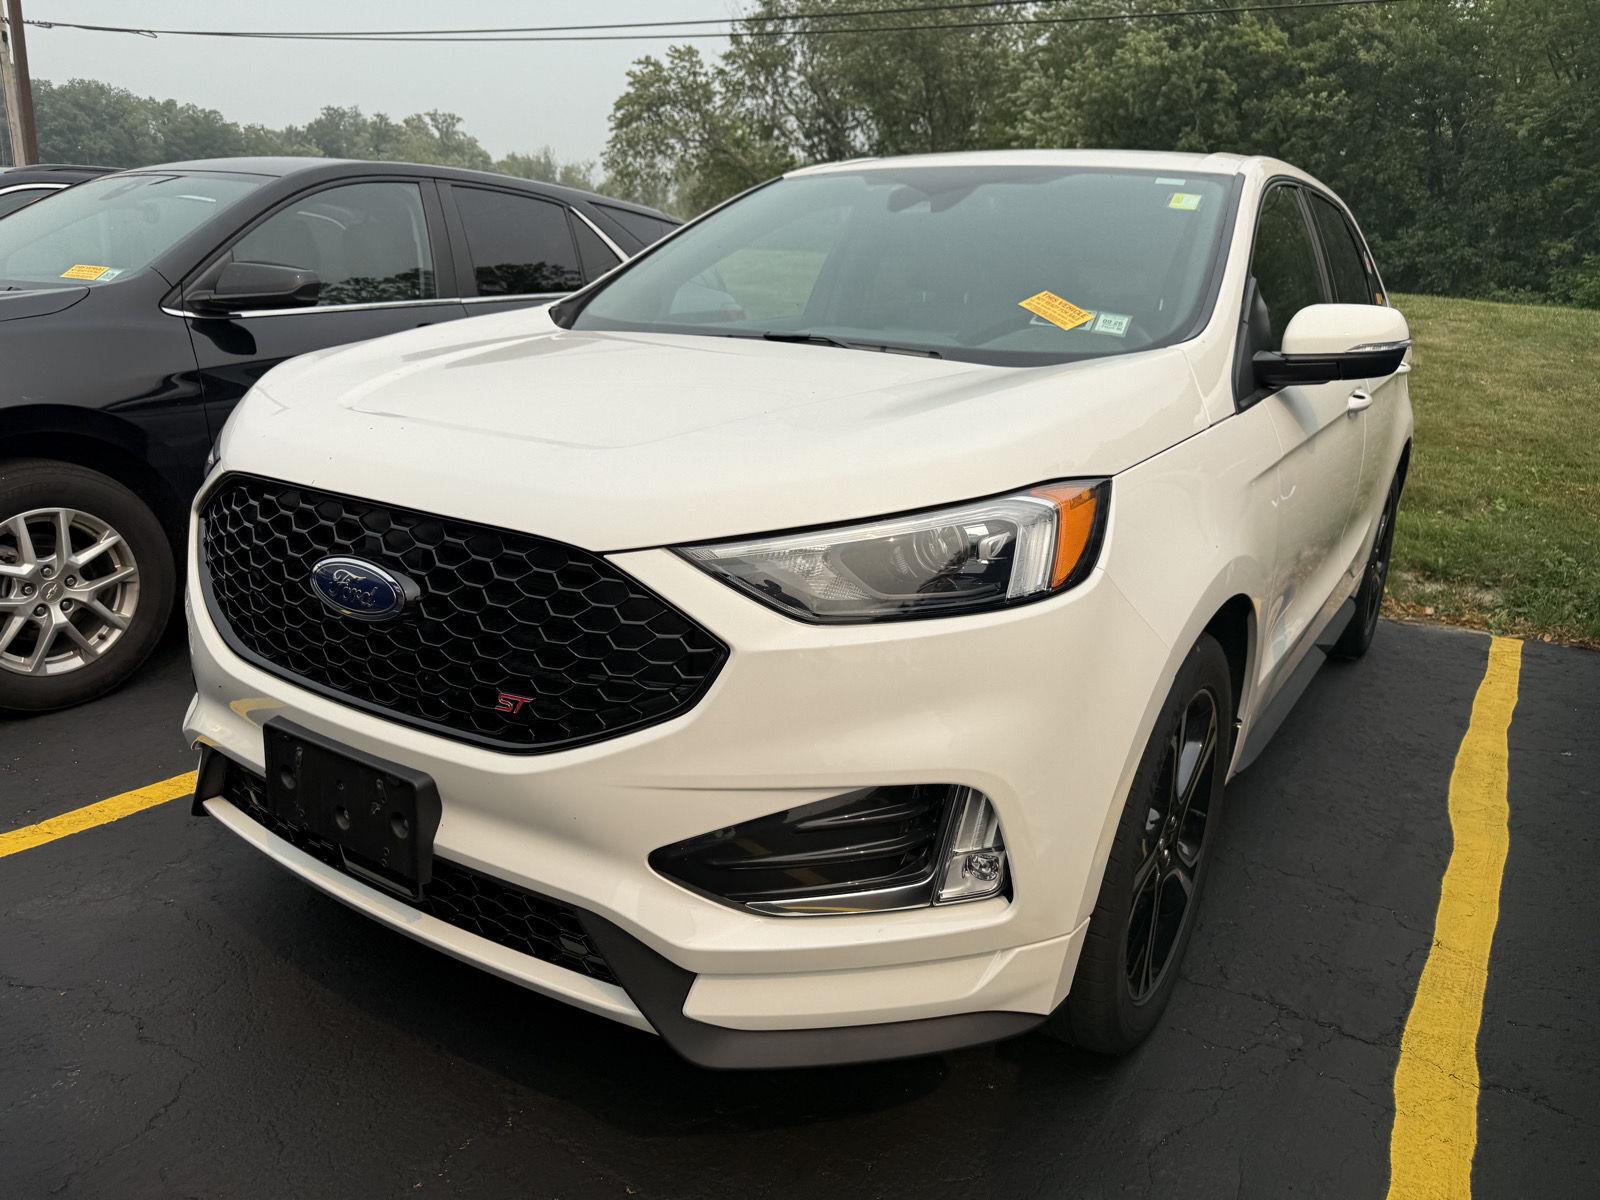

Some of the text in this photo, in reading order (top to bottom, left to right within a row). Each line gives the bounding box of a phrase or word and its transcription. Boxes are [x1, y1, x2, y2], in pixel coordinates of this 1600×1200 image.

[1042, 292, 1058, 303] THIS
[1058, 299, 1088, 319] VEHICLE
[328, 569, 380, 608] Ford
[495, 692, 534, 714] ST
